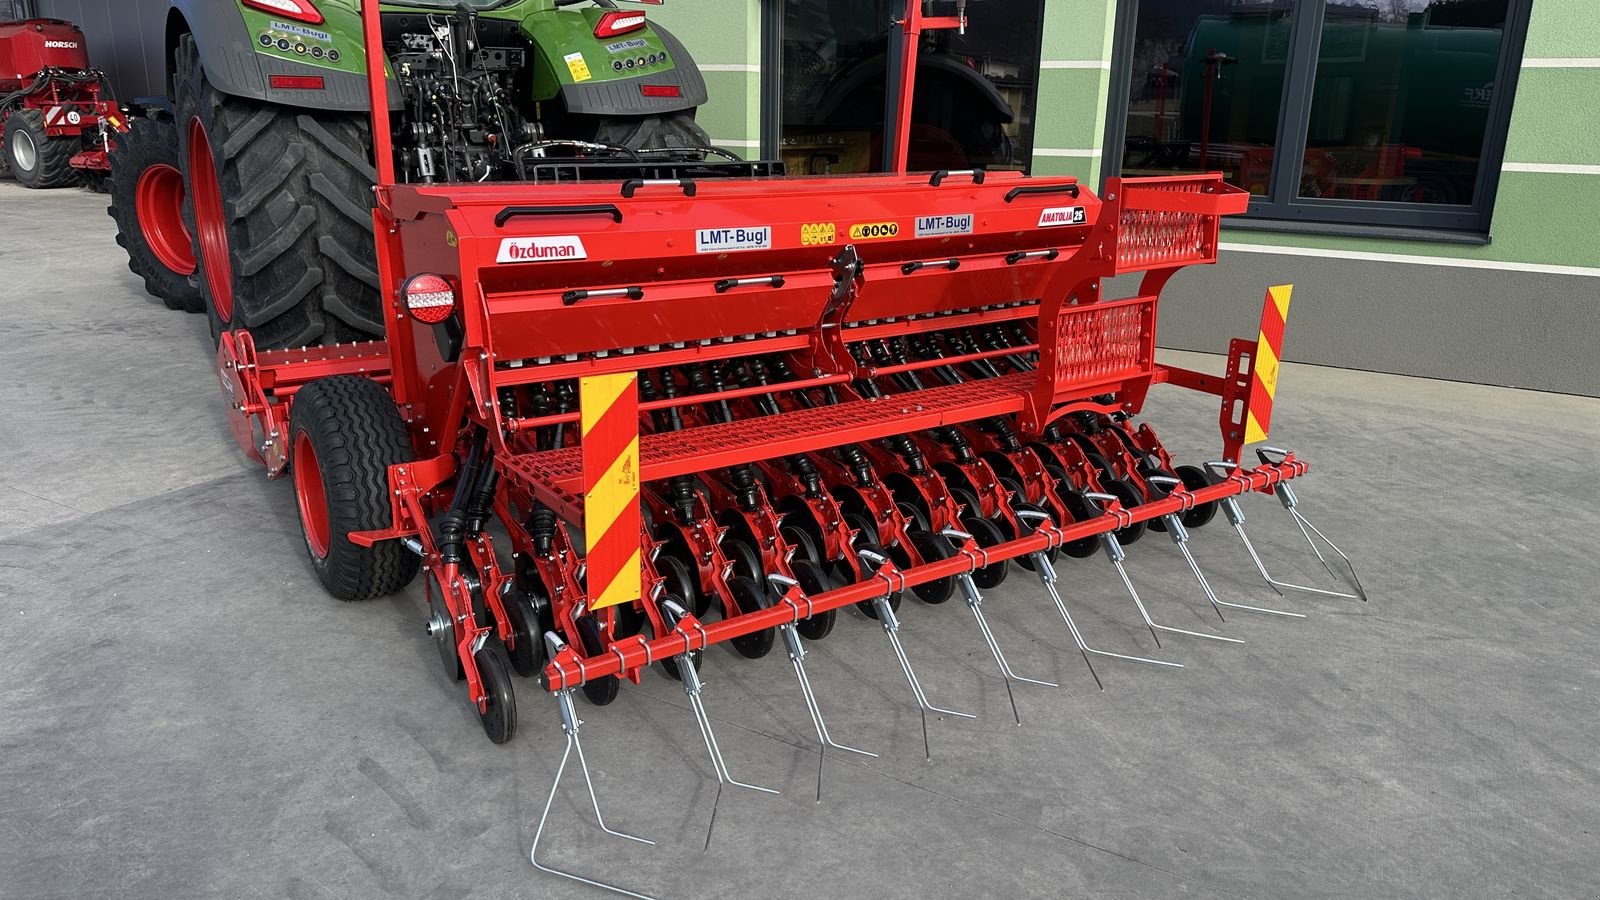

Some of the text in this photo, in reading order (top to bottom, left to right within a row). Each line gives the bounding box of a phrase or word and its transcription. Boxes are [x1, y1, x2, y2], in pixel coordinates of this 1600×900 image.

[274, 22, 328, 39] LMT-Bugl
[44, 40, 78, 49] HORSCH
[608, 39, 646, 51] LMT-Bugl
[69, 113, 78, 122] 40
[918, 215, 970, 230] LMT-Bugl
[1041, 210, 1084, 223] ANATOLIA 25
[700, 228, 767, 244] LMT-Bugl
[509, 242, 575, 259] Özduman
